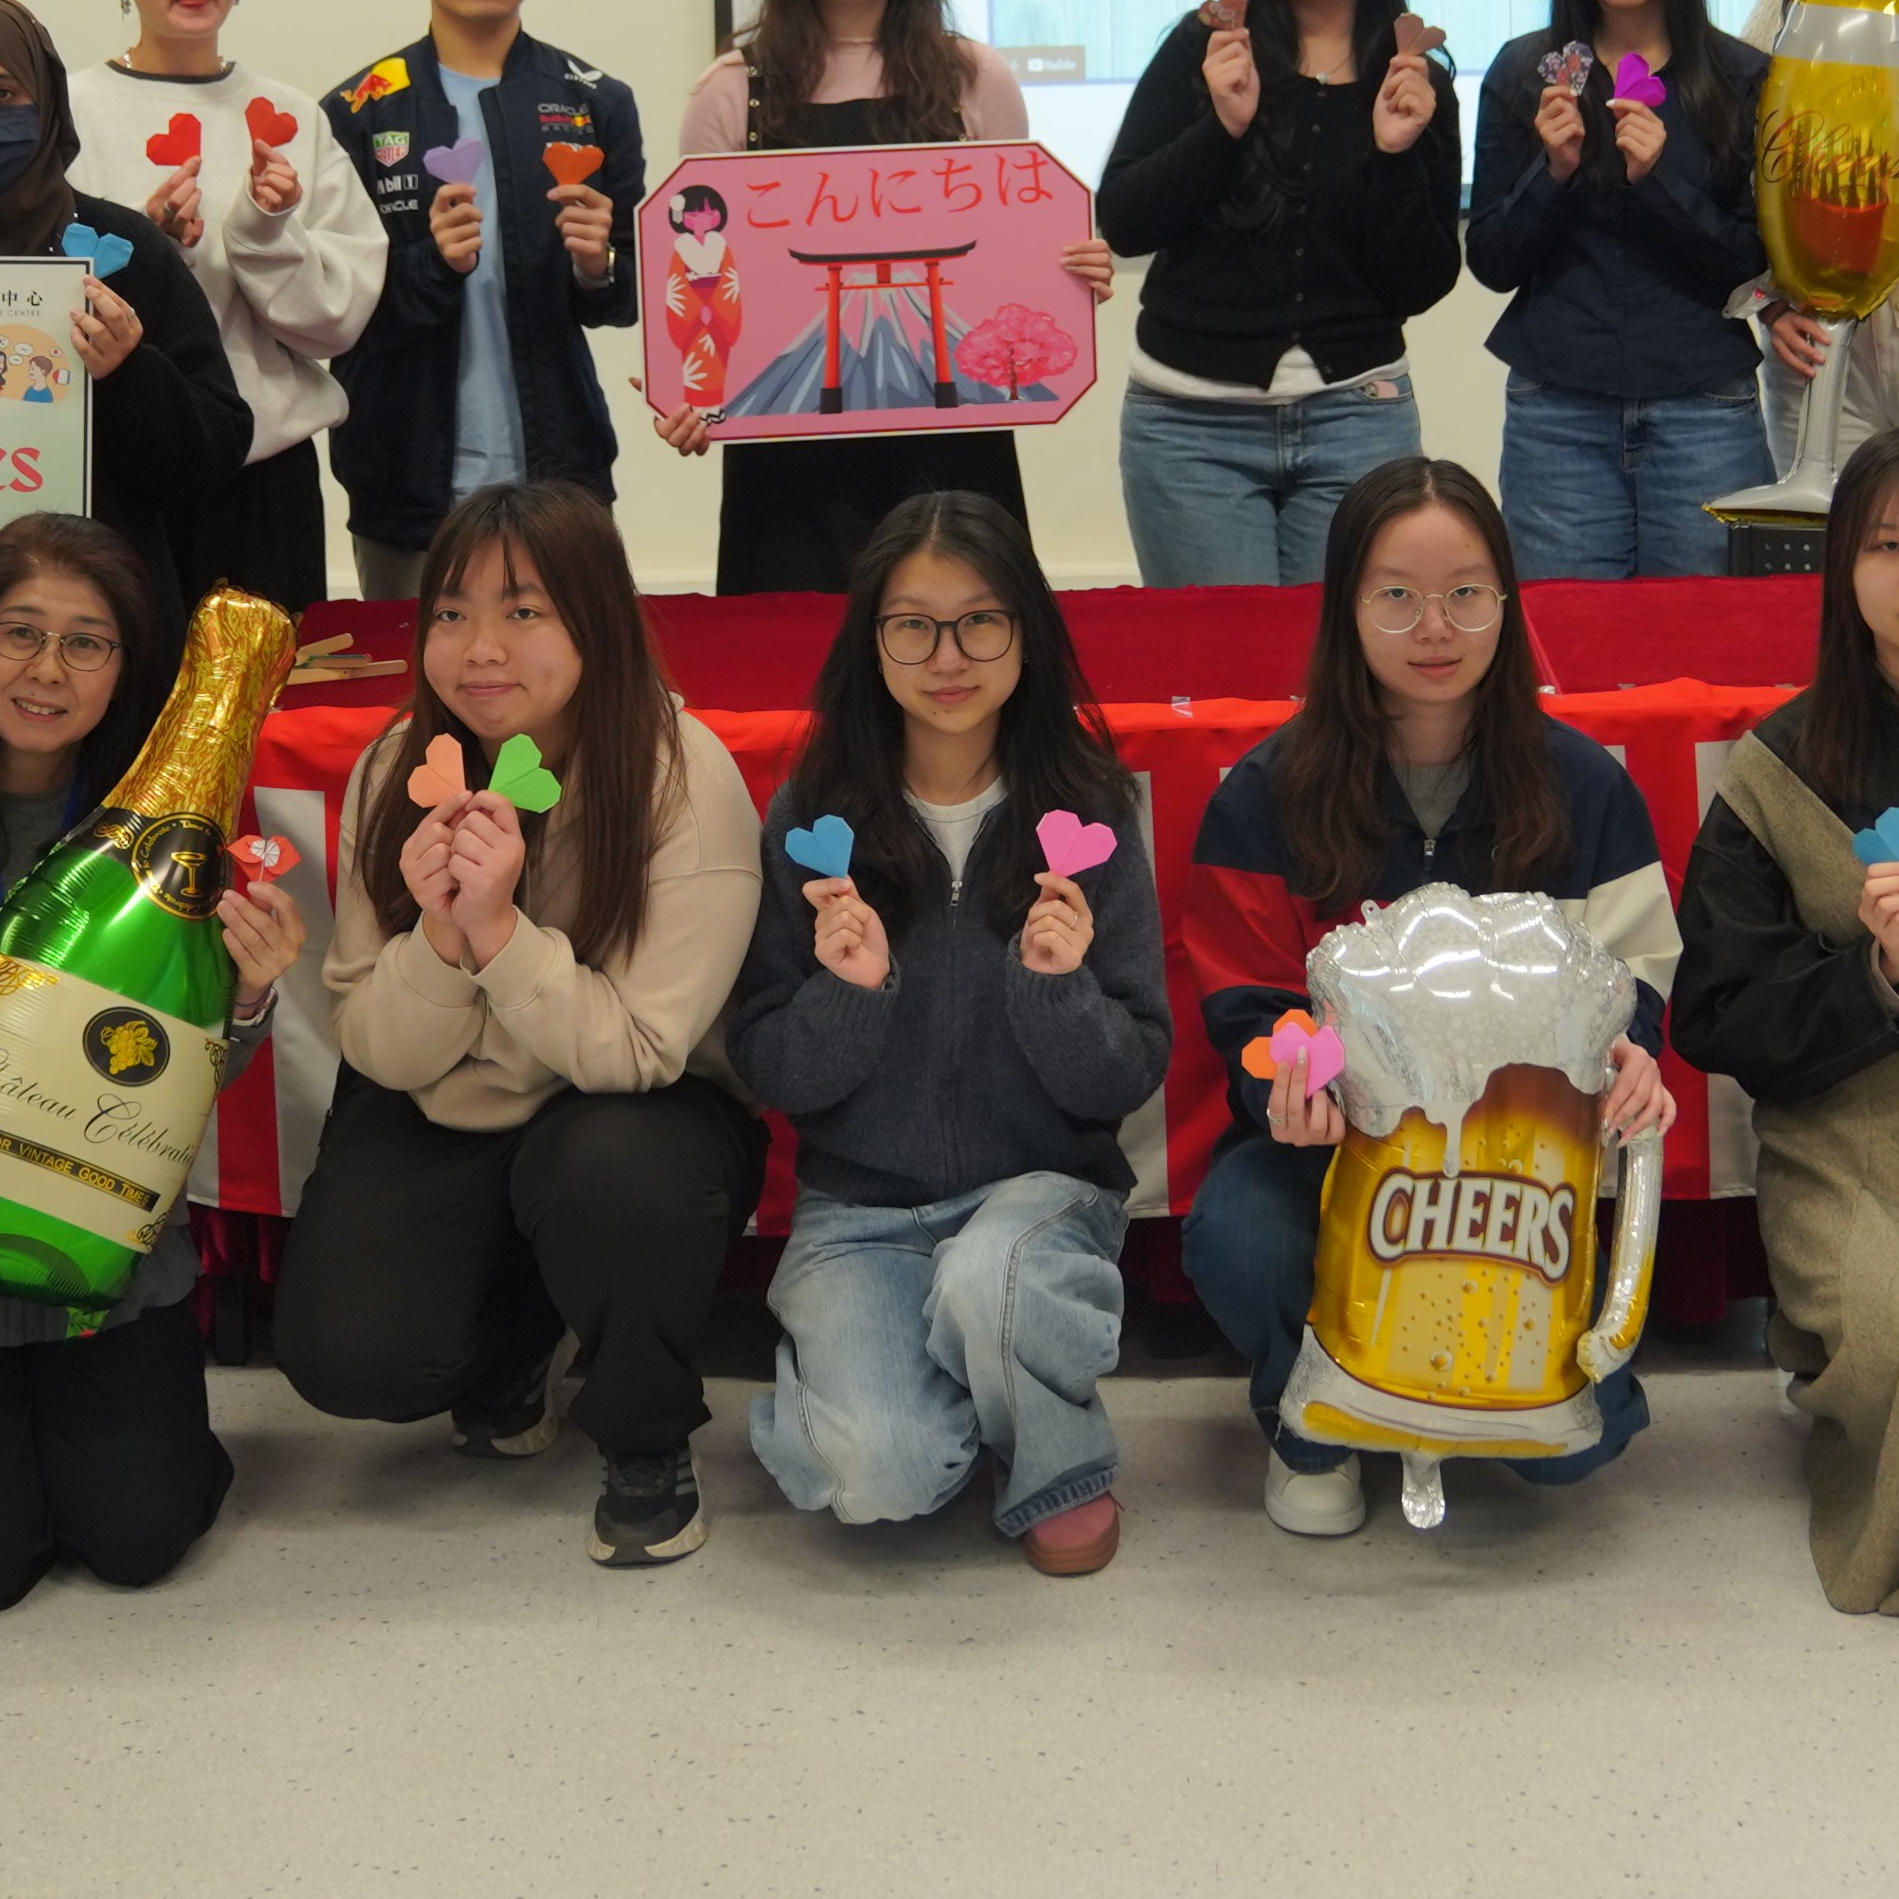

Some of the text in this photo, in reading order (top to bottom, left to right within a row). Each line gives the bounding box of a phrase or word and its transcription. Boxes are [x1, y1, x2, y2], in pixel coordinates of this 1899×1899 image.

[746, 150, 1055, 229] こんにちは
[7, 309, 41, 318] CENTRE
[19, 1142, 75, 1175] VINTAGE
[78, 1167, 116, 1193] GOOD
[120, 1182, 151, 1207] TIMES
[1369, 1172, 1575, 1281] CHEERS
